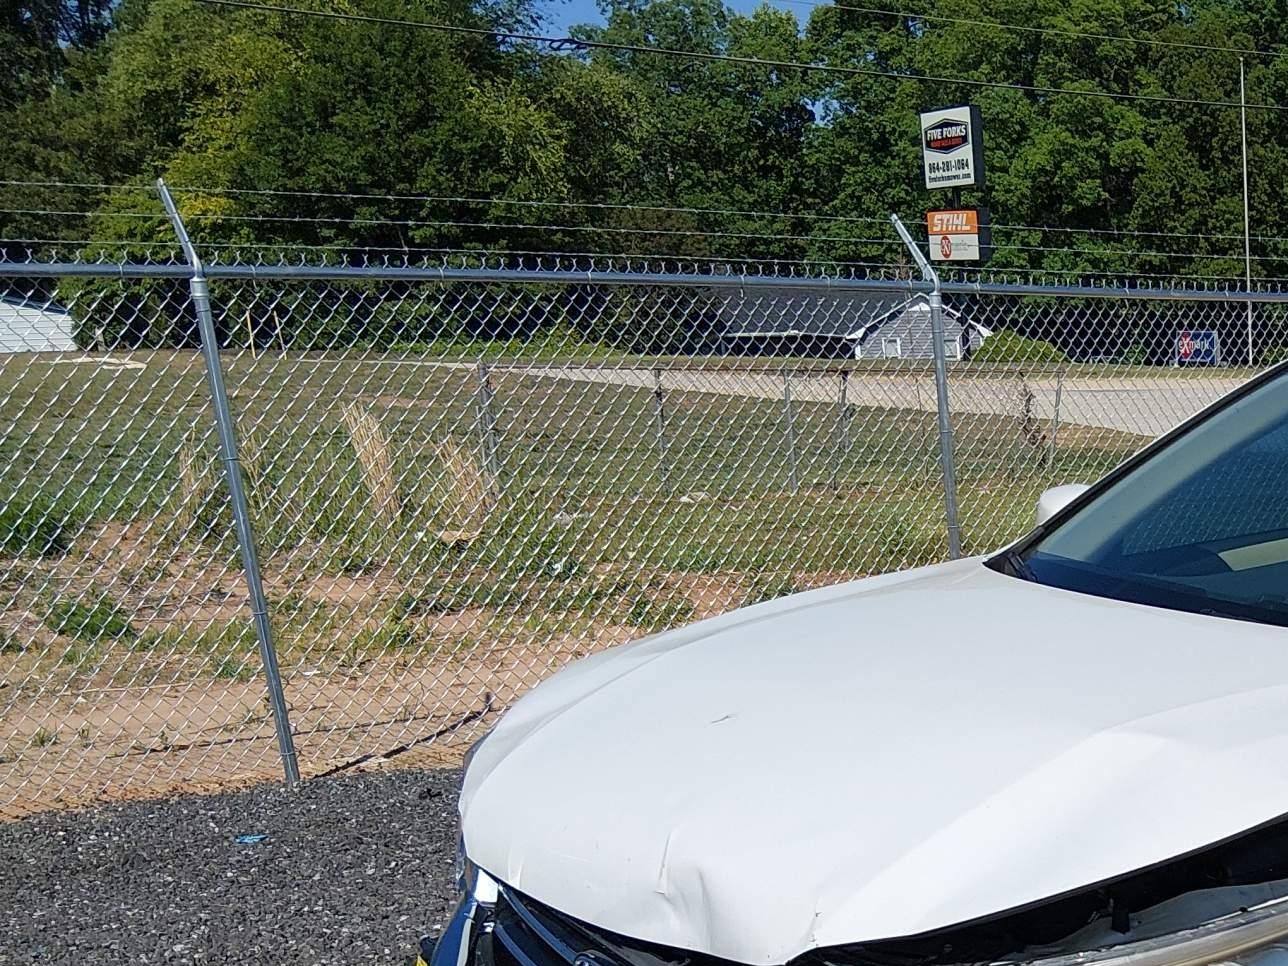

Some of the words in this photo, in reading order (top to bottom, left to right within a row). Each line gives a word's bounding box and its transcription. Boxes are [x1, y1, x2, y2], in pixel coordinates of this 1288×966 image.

[927, 128, 943, 142] FIVE
[943, 124, 966, 139] FORKS
[932, 213, 971, 232] STIHL
